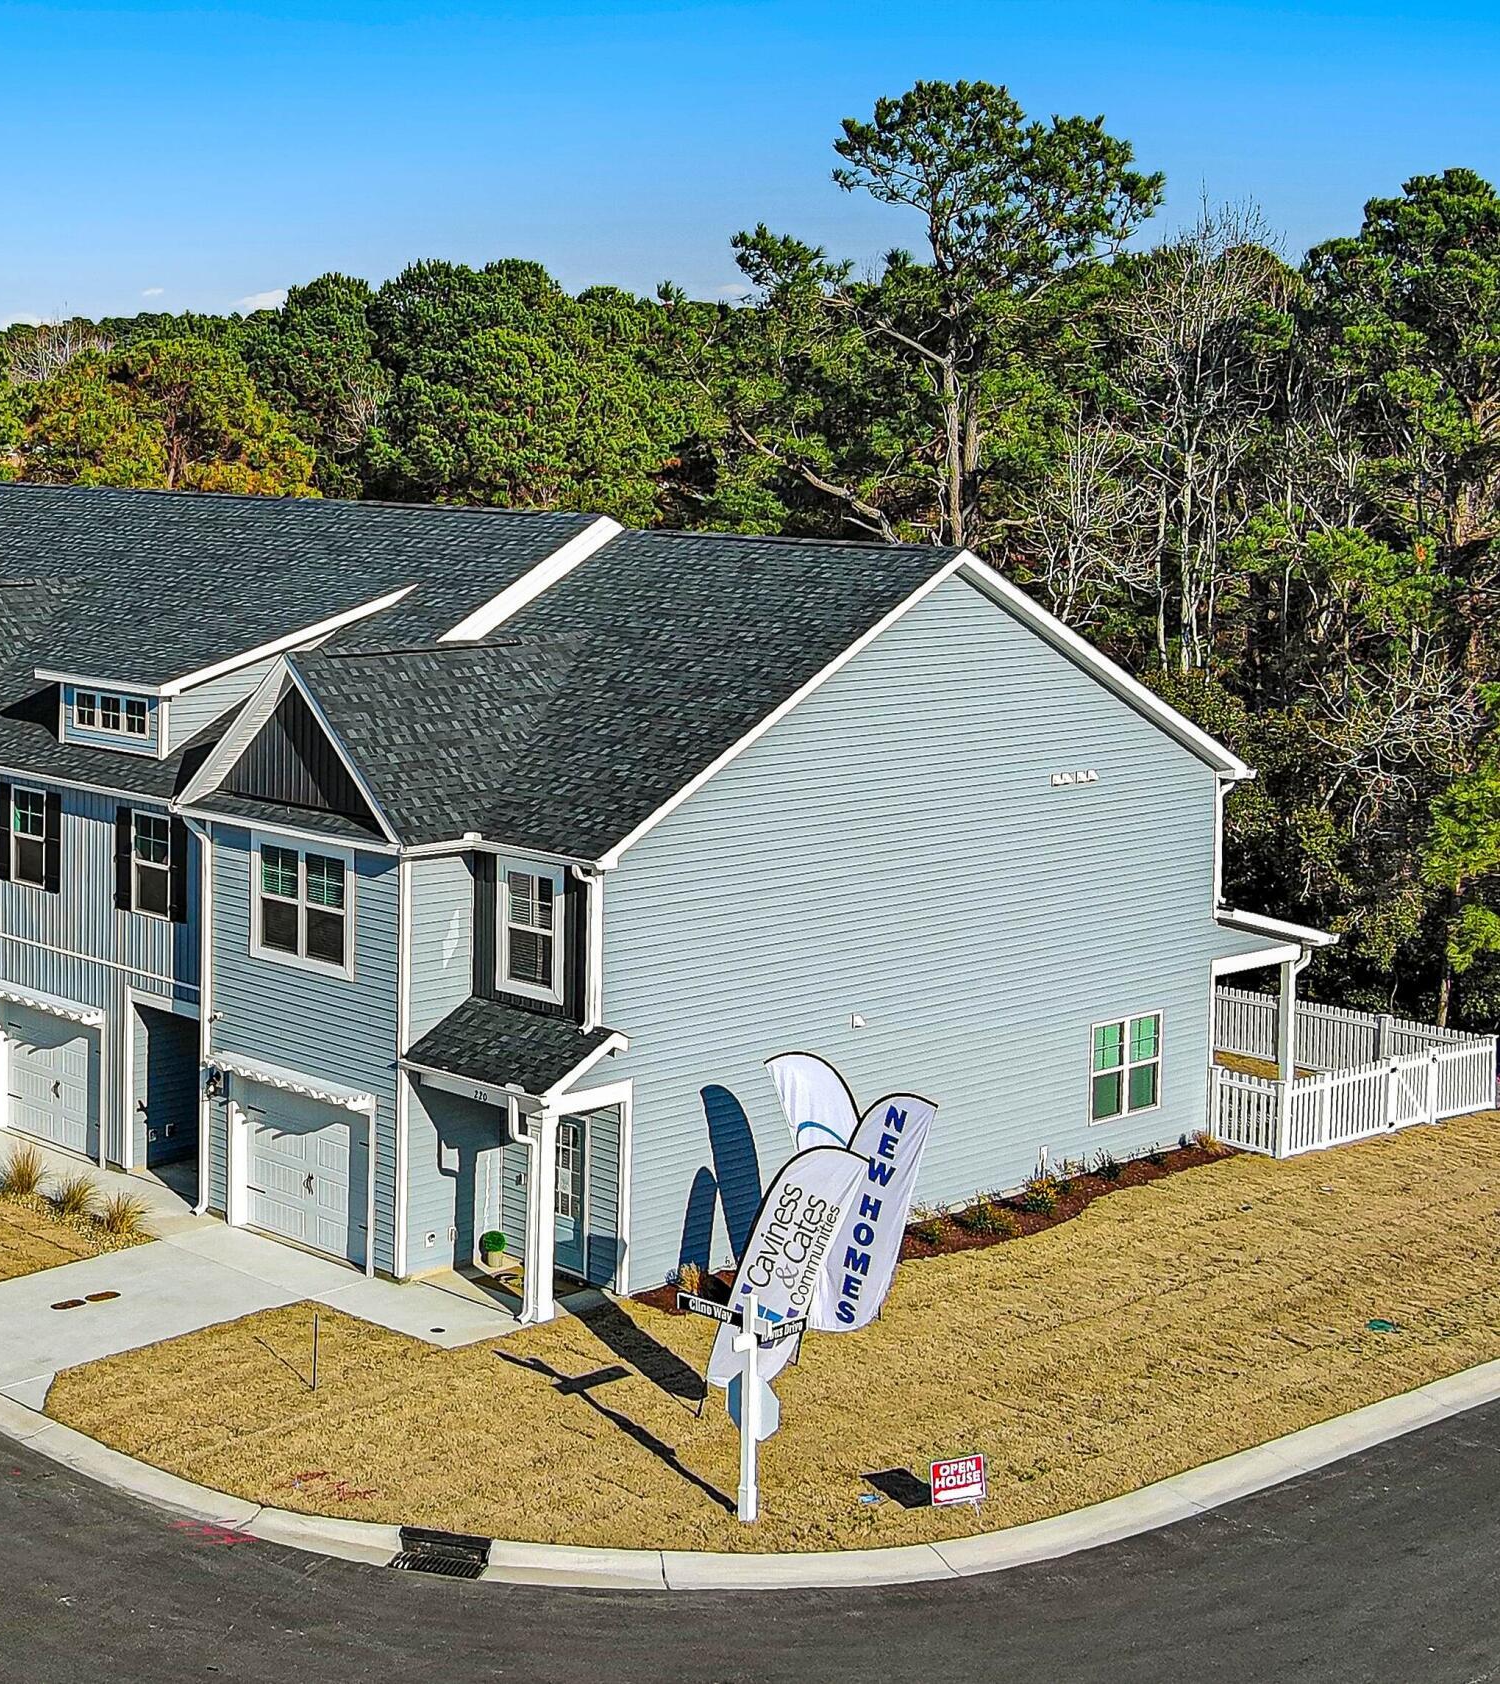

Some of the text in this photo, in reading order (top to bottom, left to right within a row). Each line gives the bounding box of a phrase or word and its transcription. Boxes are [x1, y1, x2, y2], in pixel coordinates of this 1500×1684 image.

[867, 1105, 908, 1188] NEW
[747, 1183, 803, 1287] Caviness
[775, 1194, 828, 1289] & Cates
[790, 1204, 841, 1306] Communities
[835, 1193, 883, 1325] HOMES
[712, 1306, 733, 1323] Way
[934, 1469, 981, 1489] HOUSE
[939, 1459, 977, 1477] OPEN
